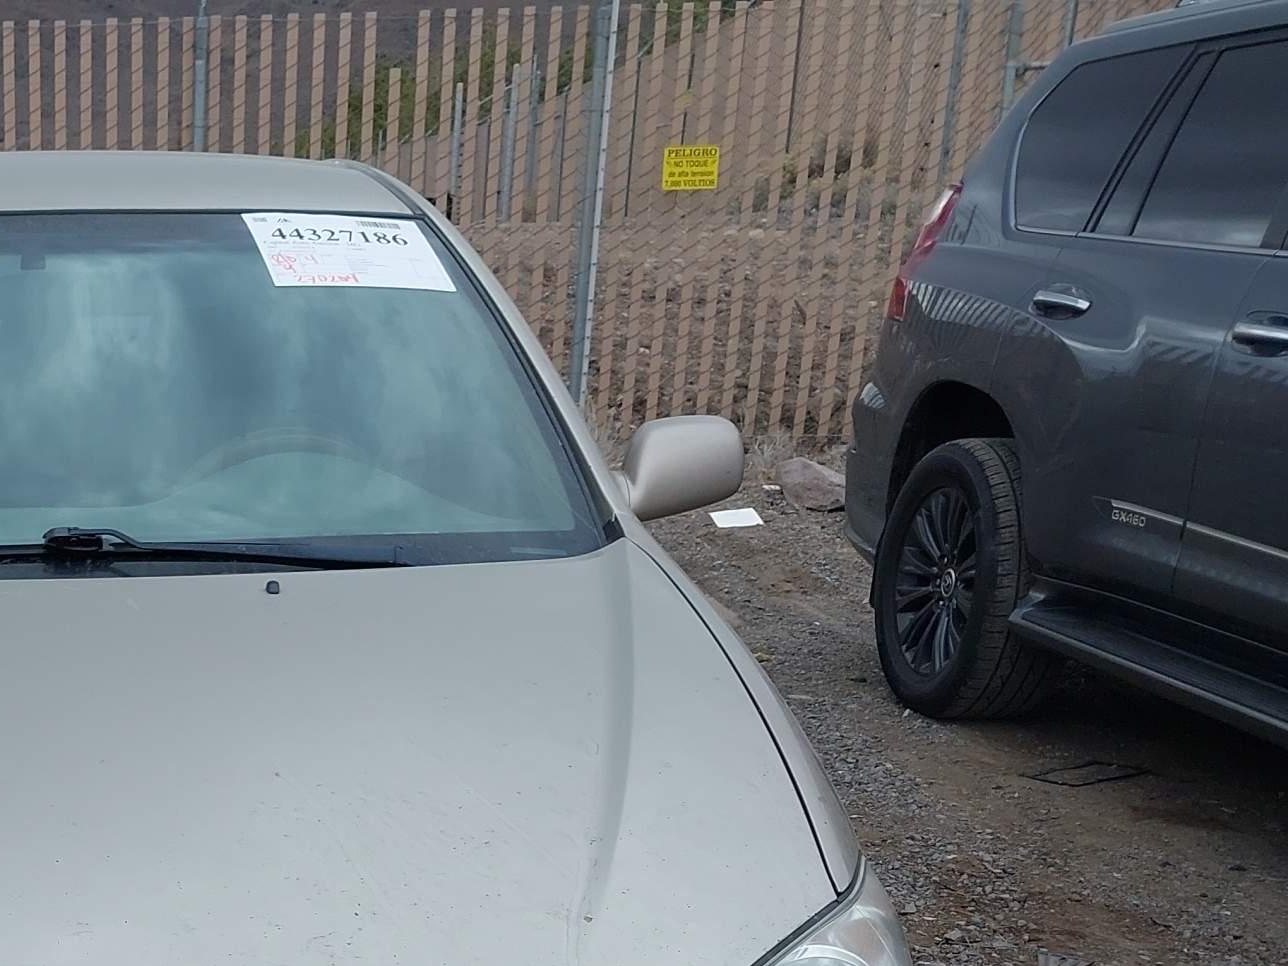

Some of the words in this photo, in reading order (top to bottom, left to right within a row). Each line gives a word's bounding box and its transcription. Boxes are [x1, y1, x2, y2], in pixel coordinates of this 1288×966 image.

[668, 148, 717, 157] PELIGRO
[271, 226, 409, 247] 44327186
[1112, 509, 1146, 527] GX460
